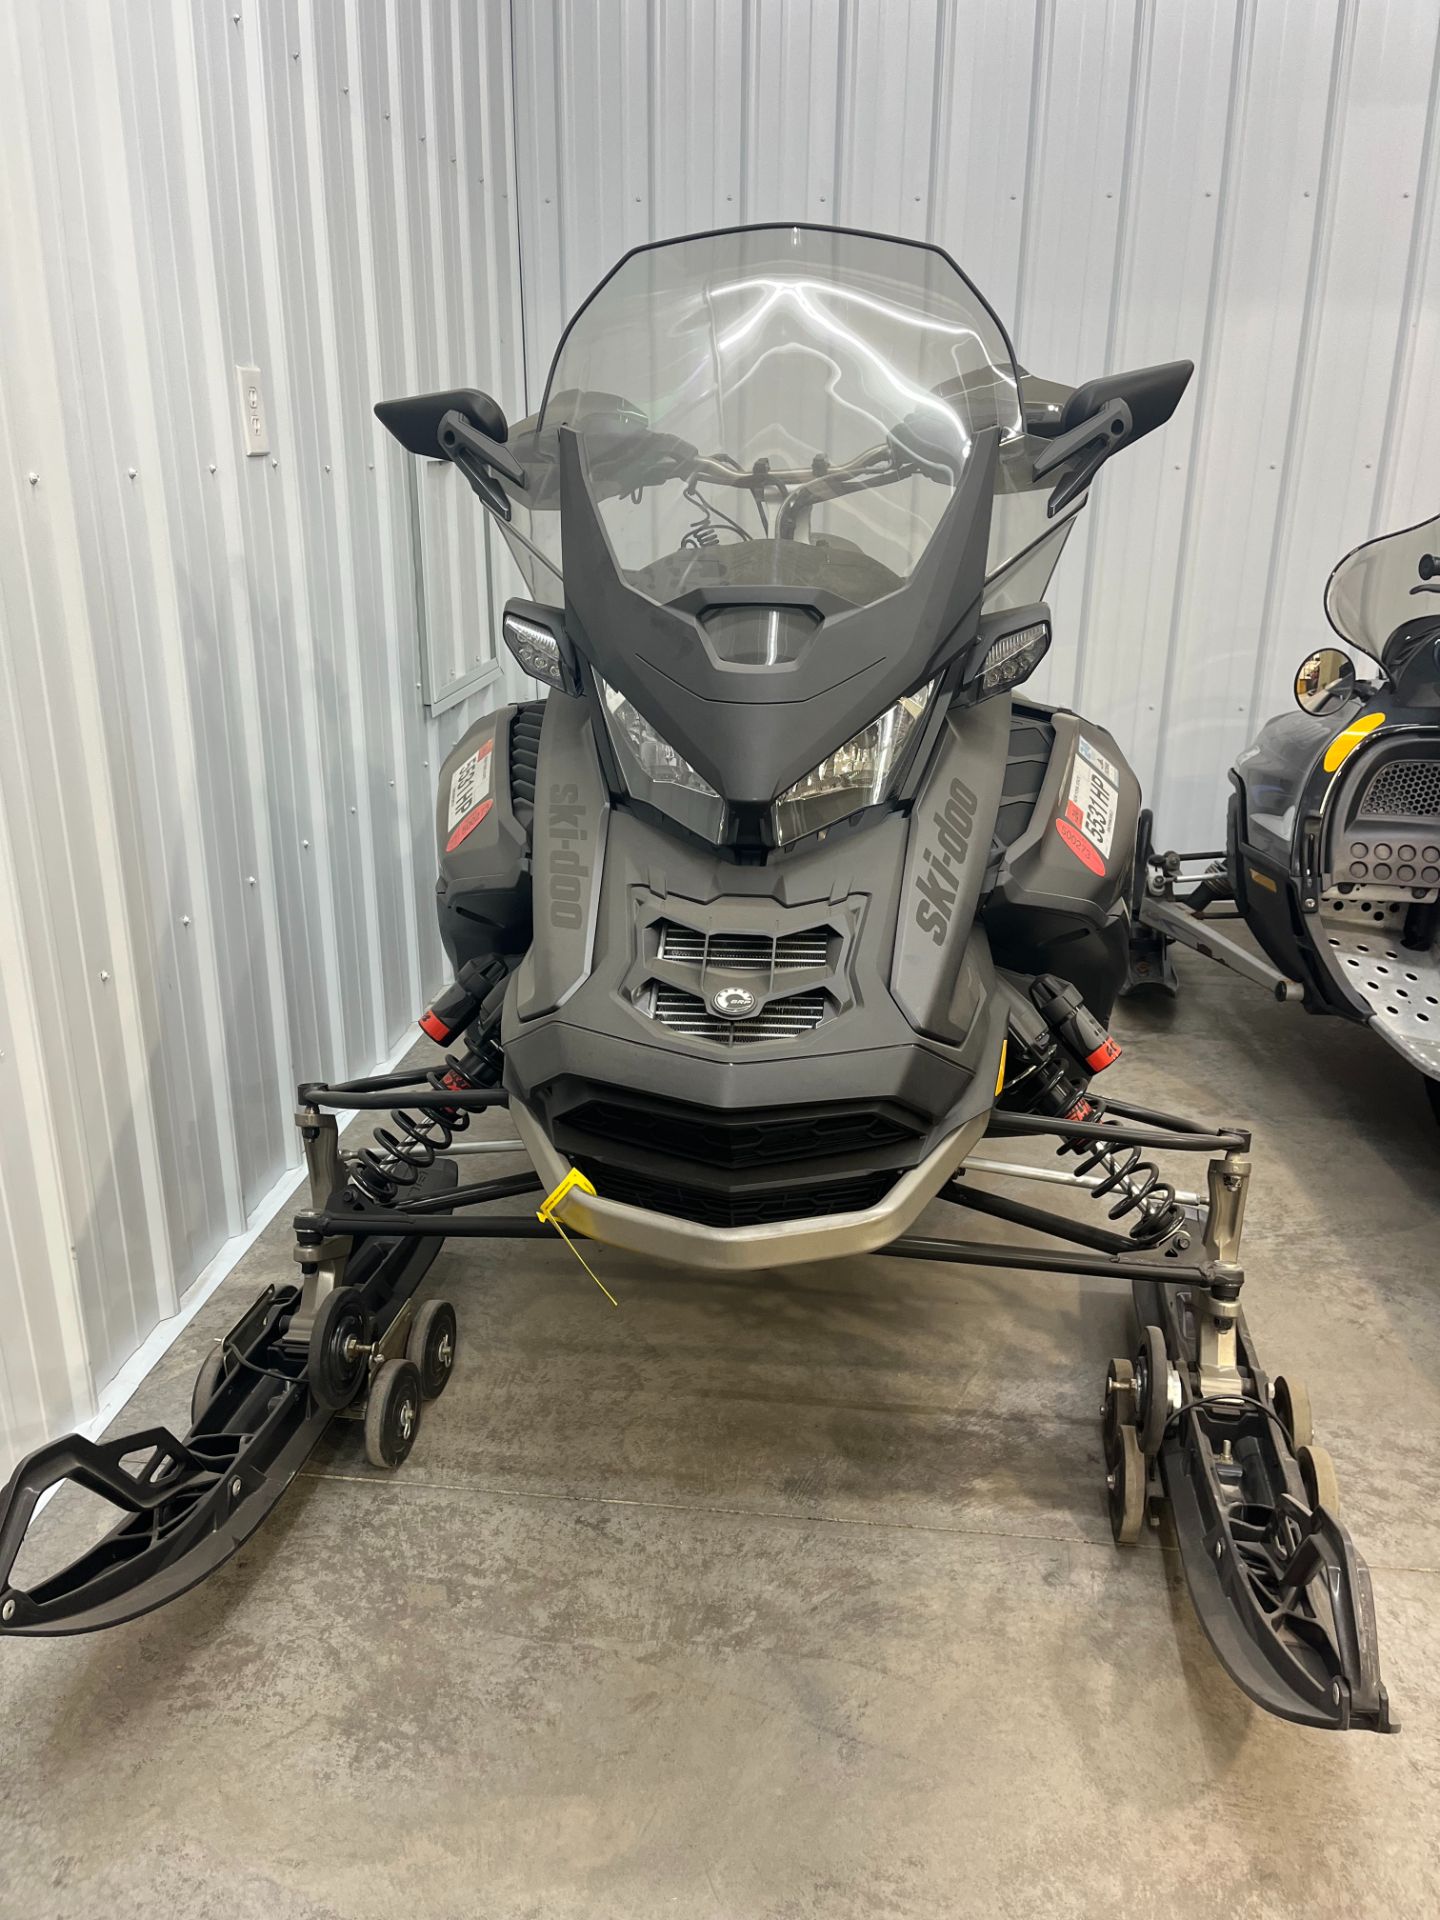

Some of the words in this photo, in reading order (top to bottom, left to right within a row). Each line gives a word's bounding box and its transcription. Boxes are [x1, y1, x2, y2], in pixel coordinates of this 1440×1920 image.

[454, 758, 477, 815] 5531HP
[1085, 774, 1110, 844] 5531HP
[549, 783, 589, 930] ski-doo
[915, 777, 978, 947] ski-doo
